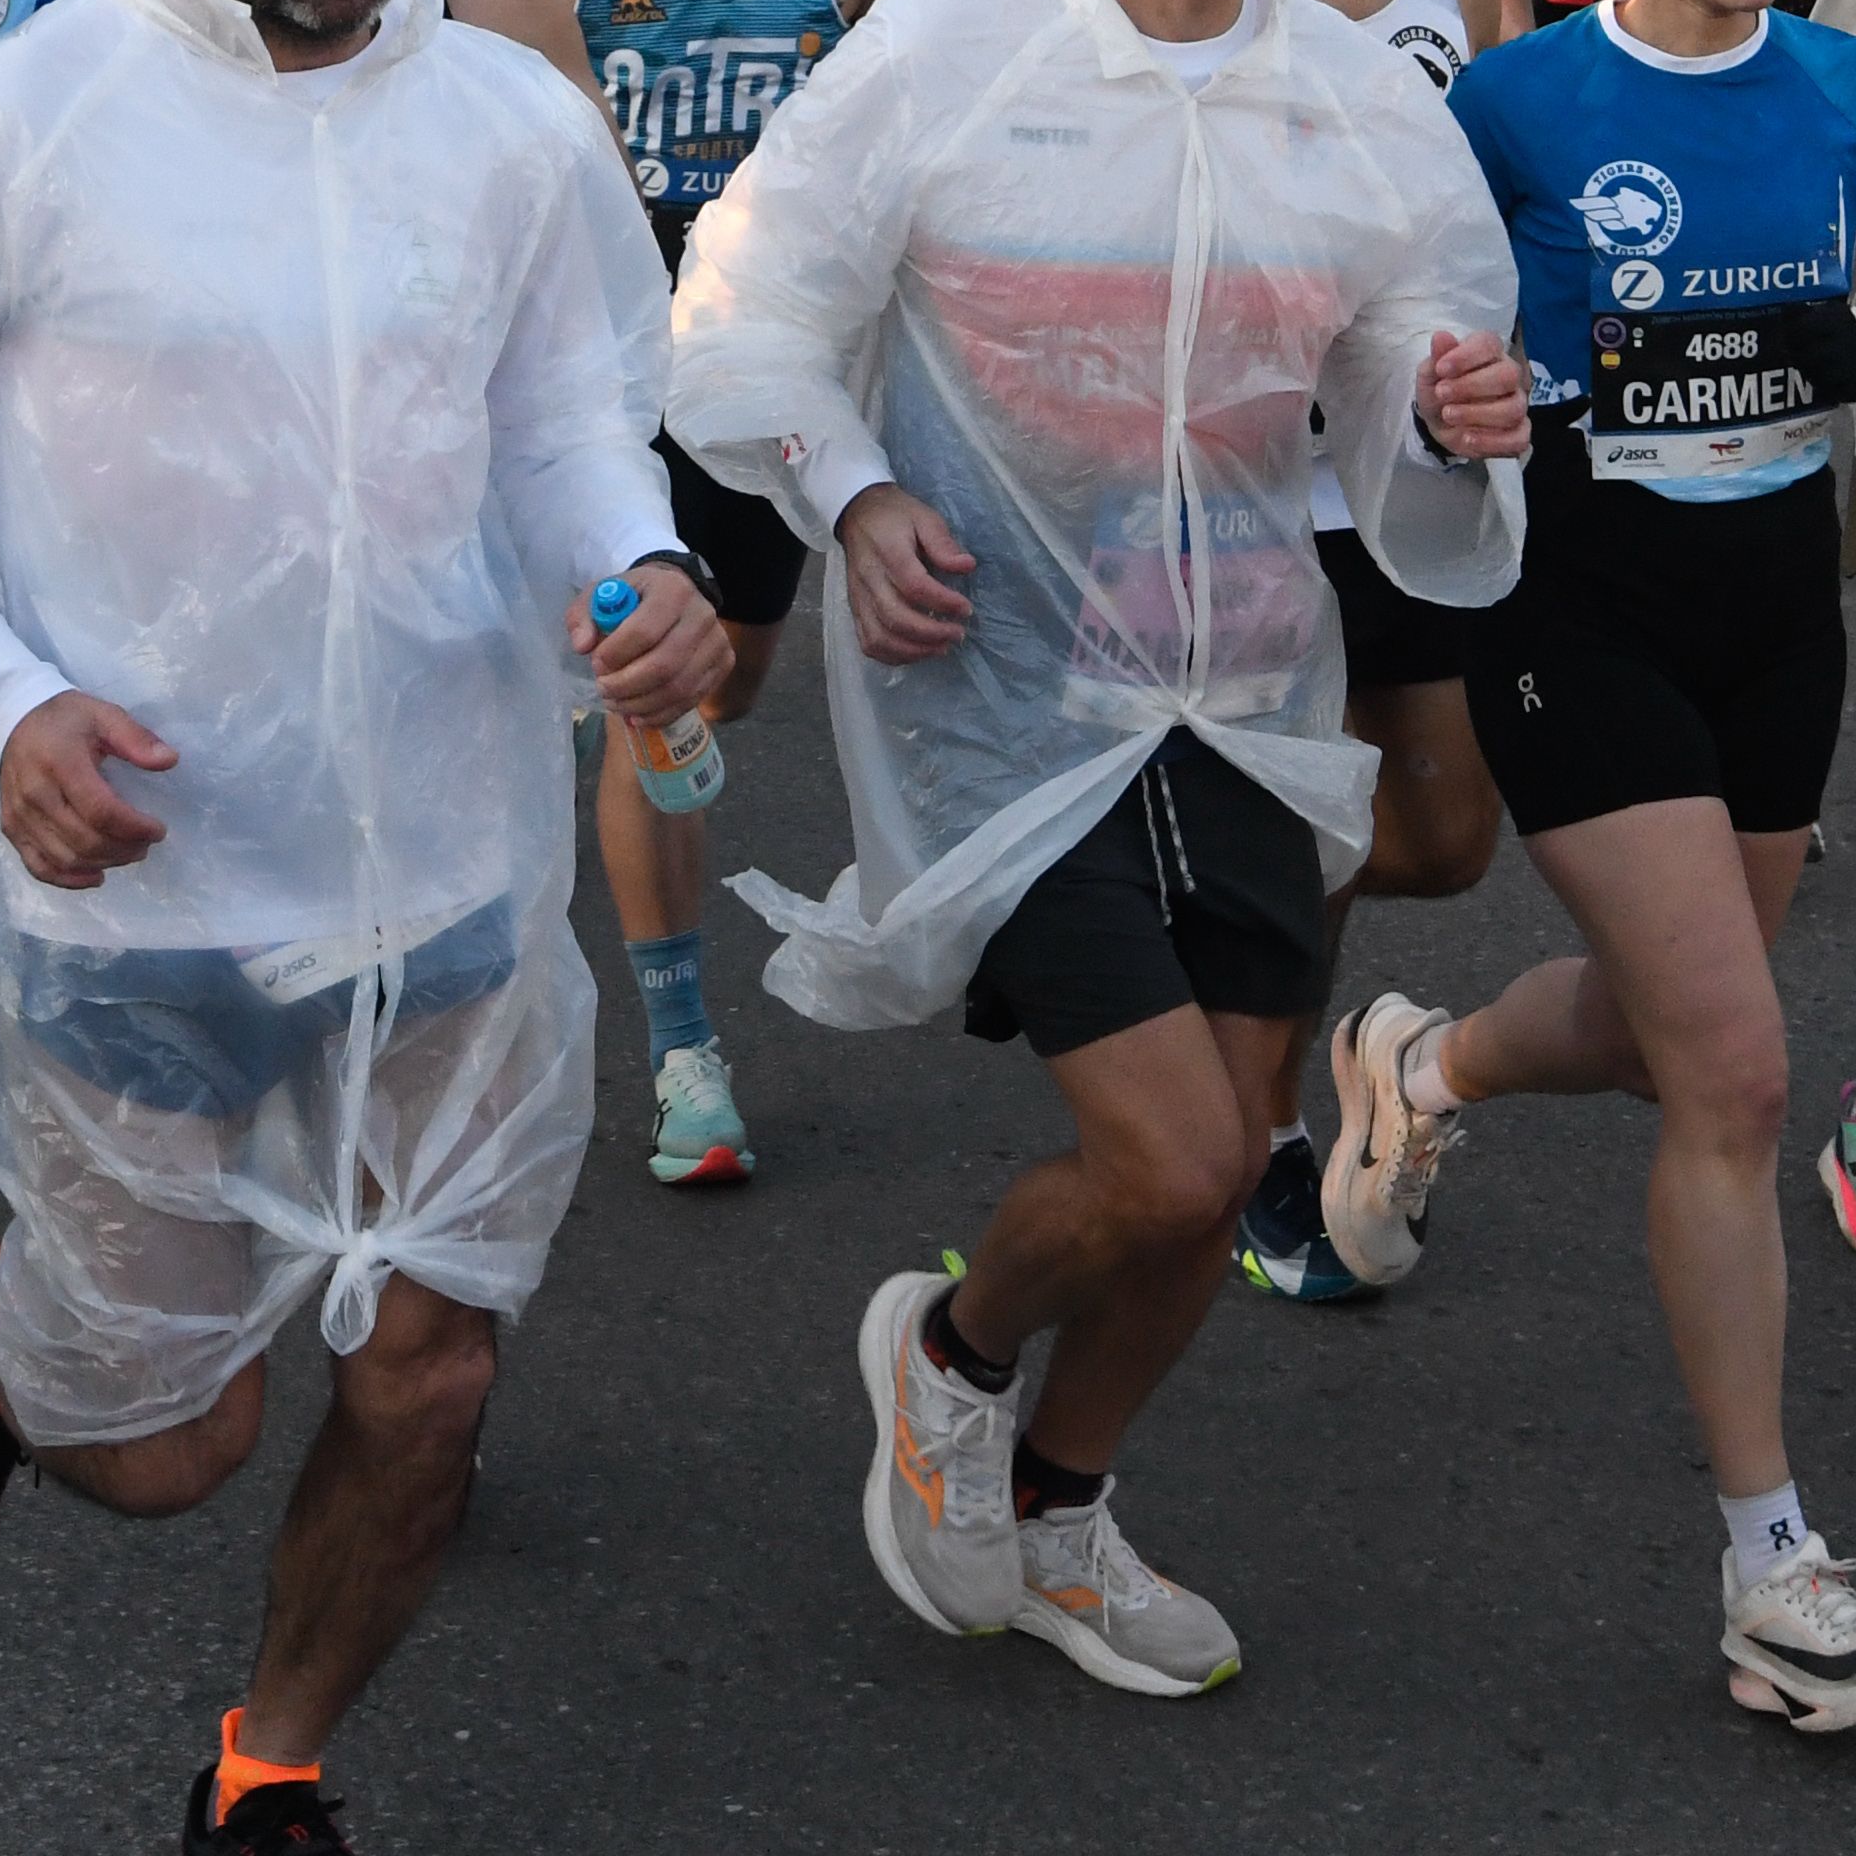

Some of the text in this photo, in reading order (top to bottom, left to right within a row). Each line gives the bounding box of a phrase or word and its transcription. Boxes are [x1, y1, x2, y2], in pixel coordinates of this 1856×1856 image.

[1593, 163, 1679, 245] TIGERS RUNNING
[1682, 259, 1820, 297] ZURICH
[1685, 330, 1759, 362] 4688
[1622, 367, 1814, 425] CARMEN
[1624, 448, 1658, 461] asics
[671, 724, 706, 762] ENCINAS
[281, 952, 317, 978] asics
